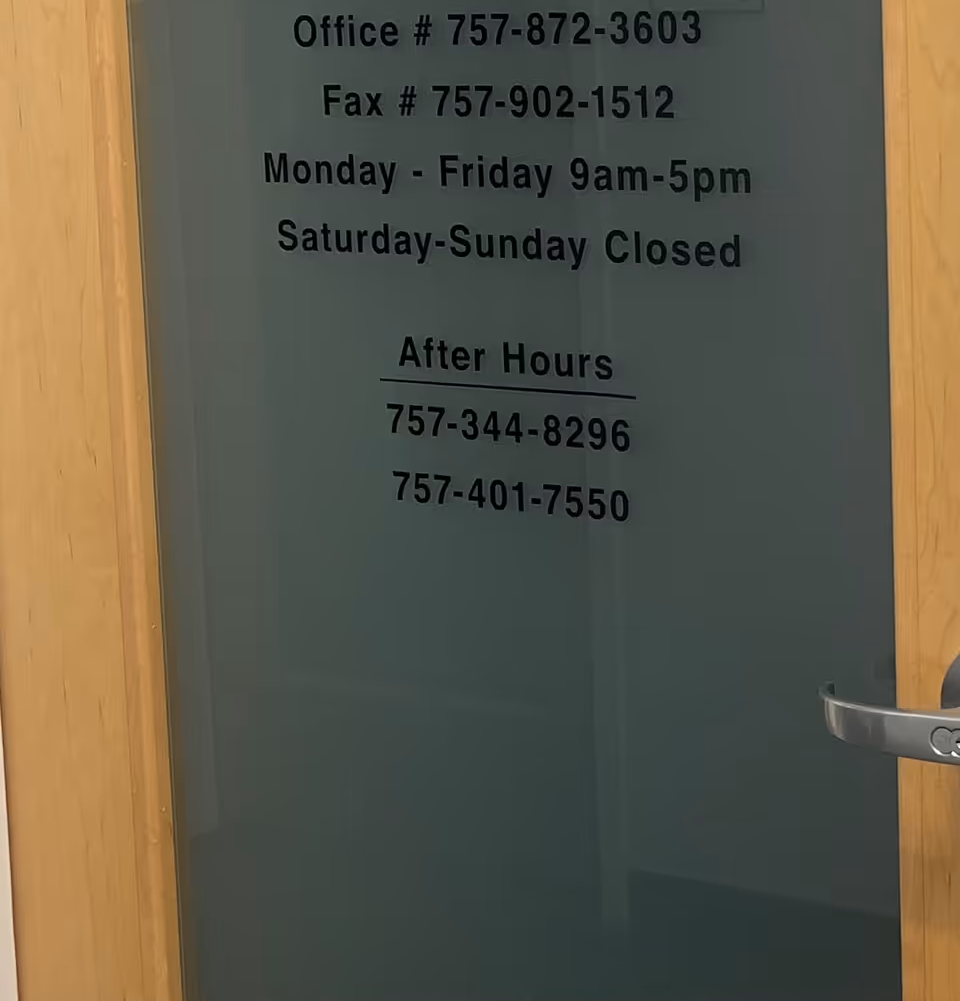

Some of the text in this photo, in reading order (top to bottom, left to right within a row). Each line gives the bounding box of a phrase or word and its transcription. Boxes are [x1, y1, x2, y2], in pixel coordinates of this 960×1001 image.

[293, 10, 702, 47] Office # 757-872-3603
[323, 85, 675, 119] Fax # 757-902-1512
[263, 152, 396, 195] Monday
[439, 155, 553, 198] Friday
[570, 158, 752, 202] 9am-5pm
[277, 219, 742, 270] Saturday-Sunday Closed
[399, 336, 613, 380] After Hours
[386, 403, 631, 452] 757-344-8296
[392, 471, 630, 522] 757-401-7550
